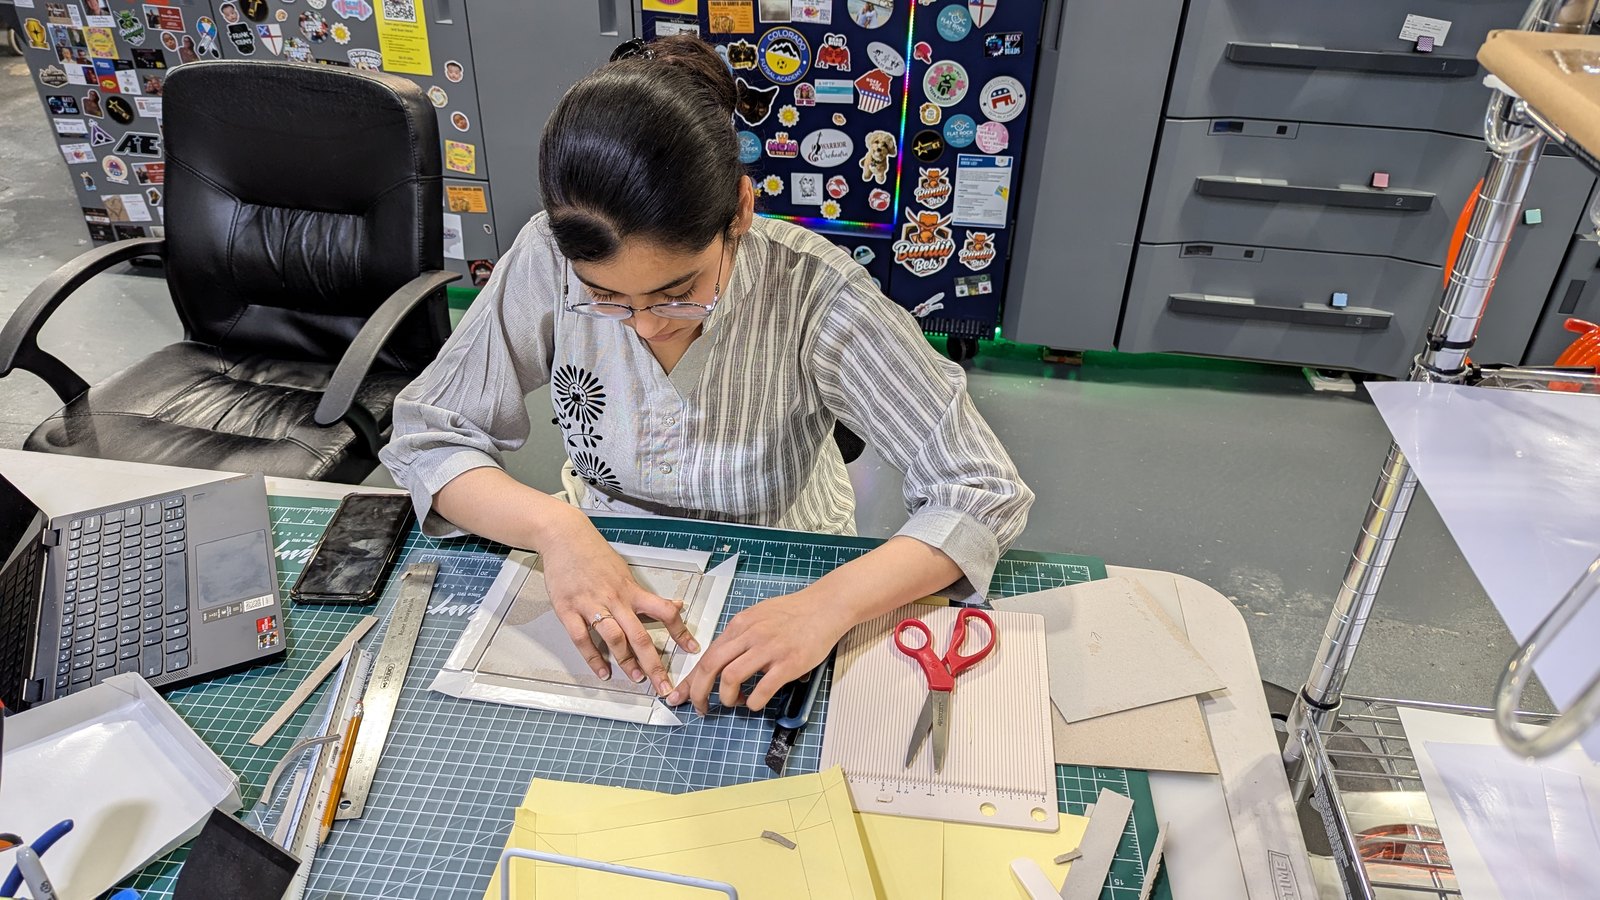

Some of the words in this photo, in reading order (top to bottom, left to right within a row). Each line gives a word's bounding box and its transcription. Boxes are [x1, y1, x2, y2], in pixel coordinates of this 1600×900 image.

[768, 30, 806, 51] COLORADO
[760, 58, 777, 80] FUTSAL
[776, 69, 803, 82] ACADEMY
[1442, 62, 1447, 71] 1
[768, 142, 797, 151] MOM
[820, 150, 849, 160] Orchestra
[916, 185, 949, 201] Bandit
[1396, 198, 1404, 206] 2
[894, 240, 953, 262] Bandit
[960, 250, 993, 262] Bandit
[1356, 317, 1362, 325] 3
